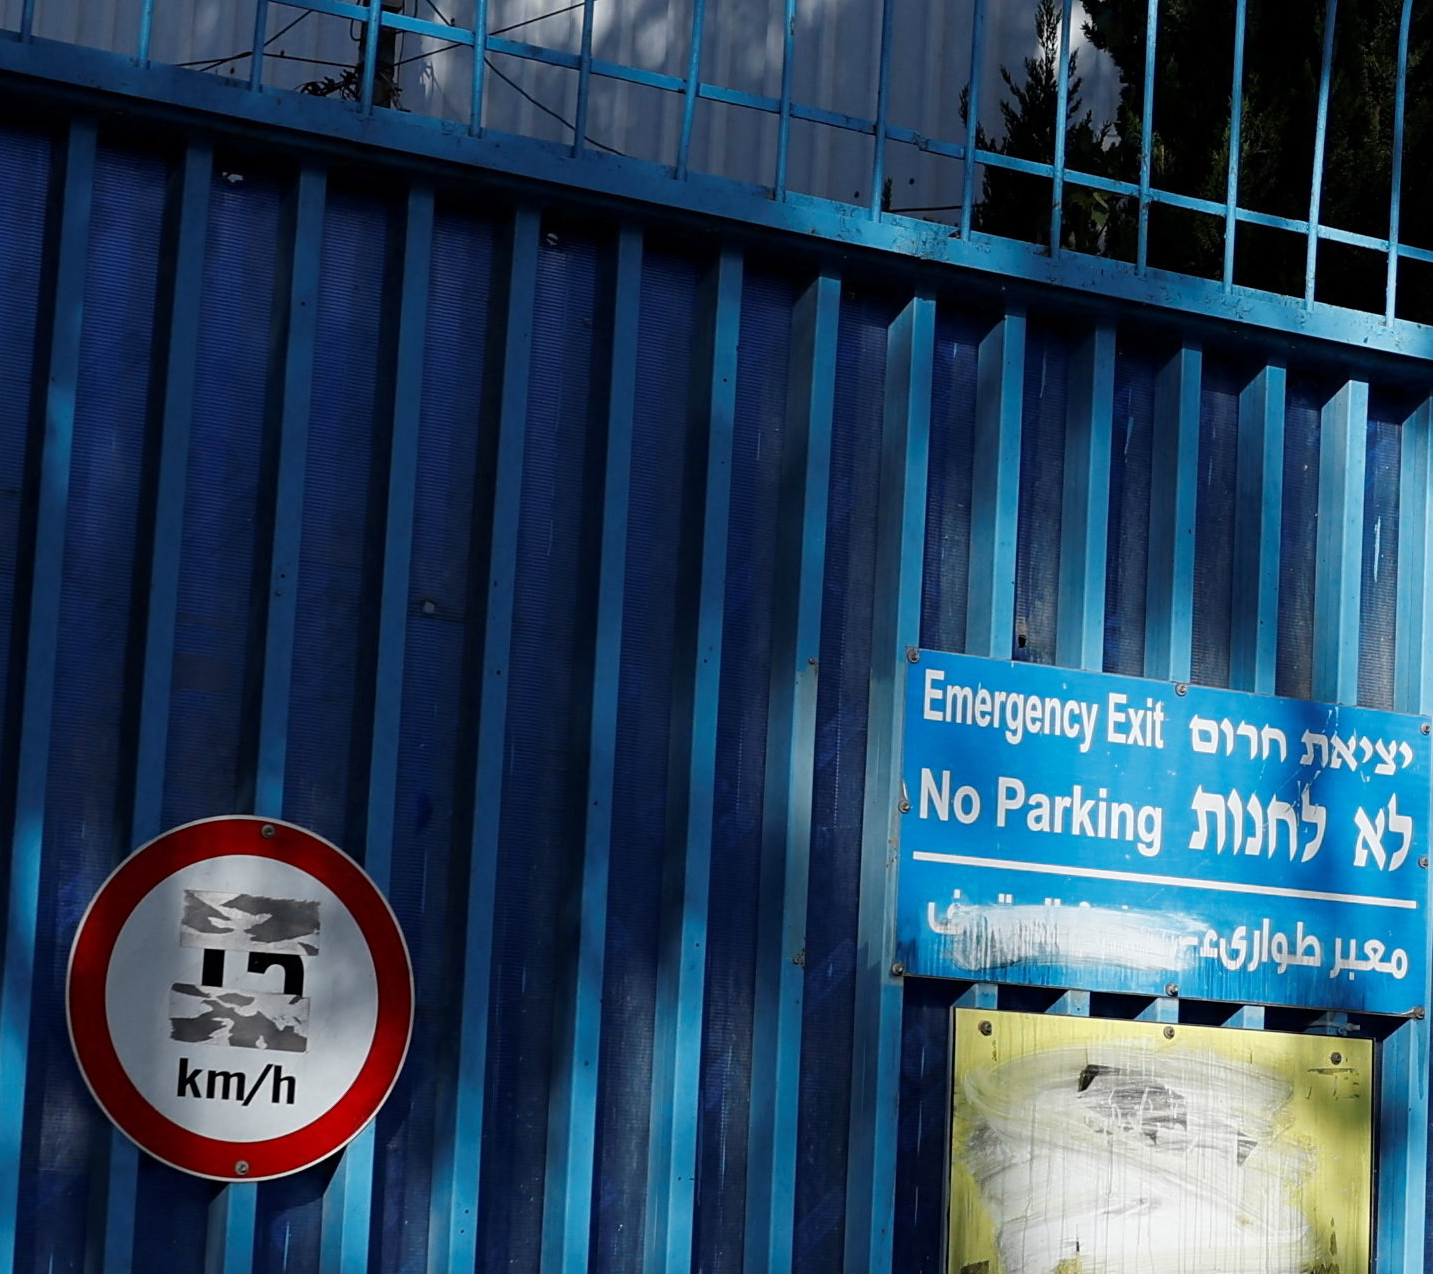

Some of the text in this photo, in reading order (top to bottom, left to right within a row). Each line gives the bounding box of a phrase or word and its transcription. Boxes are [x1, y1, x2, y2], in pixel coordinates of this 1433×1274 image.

[922, 668, 1166, 754] Emergency Exit
[1189, 713, 1414, 776] יציאת חרום
[919, 767, 1163, 858] No Parking
[1188, 784, 1414, 872] לא לחנות
[1329, 937, 1409, 981] معبر
[176, 1057, 296, 1107] km/h
